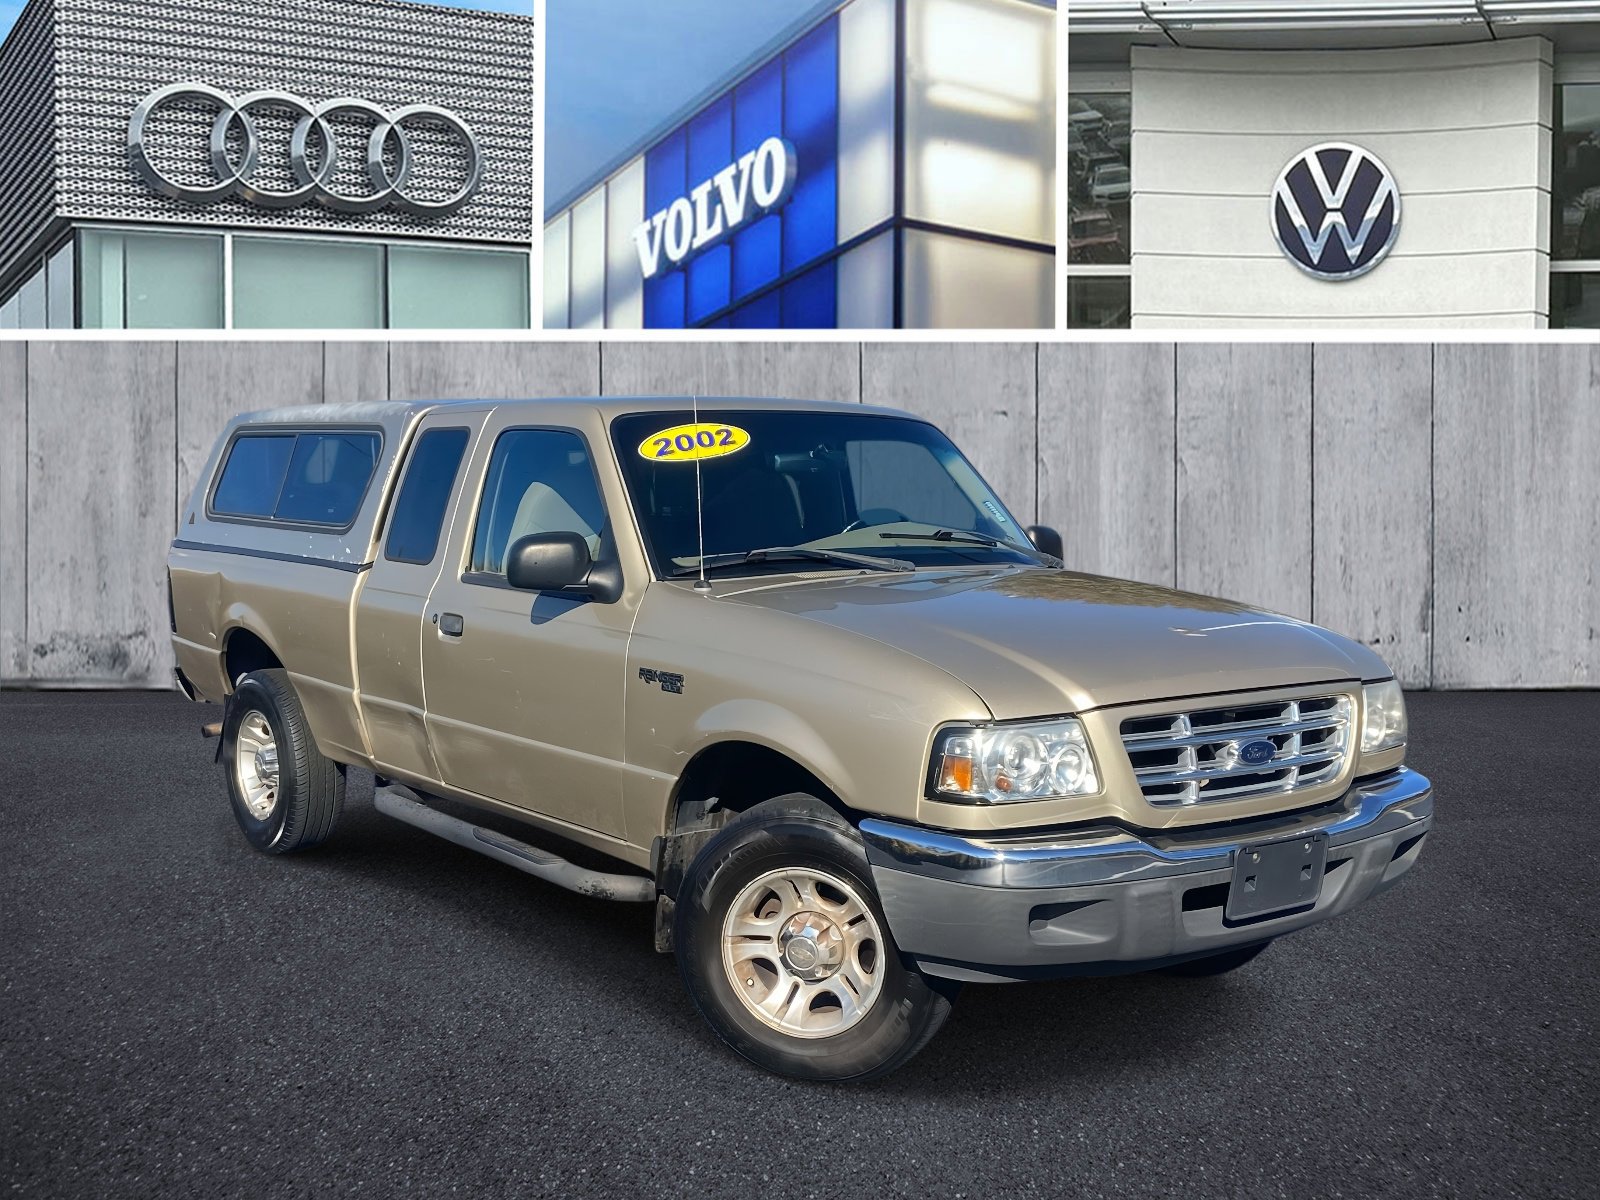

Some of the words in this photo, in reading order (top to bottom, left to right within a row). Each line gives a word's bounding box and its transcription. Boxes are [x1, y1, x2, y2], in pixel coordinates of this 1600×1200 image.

[632, 137, 789, 279] VOLVO
[1272, 144, 1399, 276] VW
[653, 428, 736, 457] 2002
[1246, 745, 1269, 759] Ford
